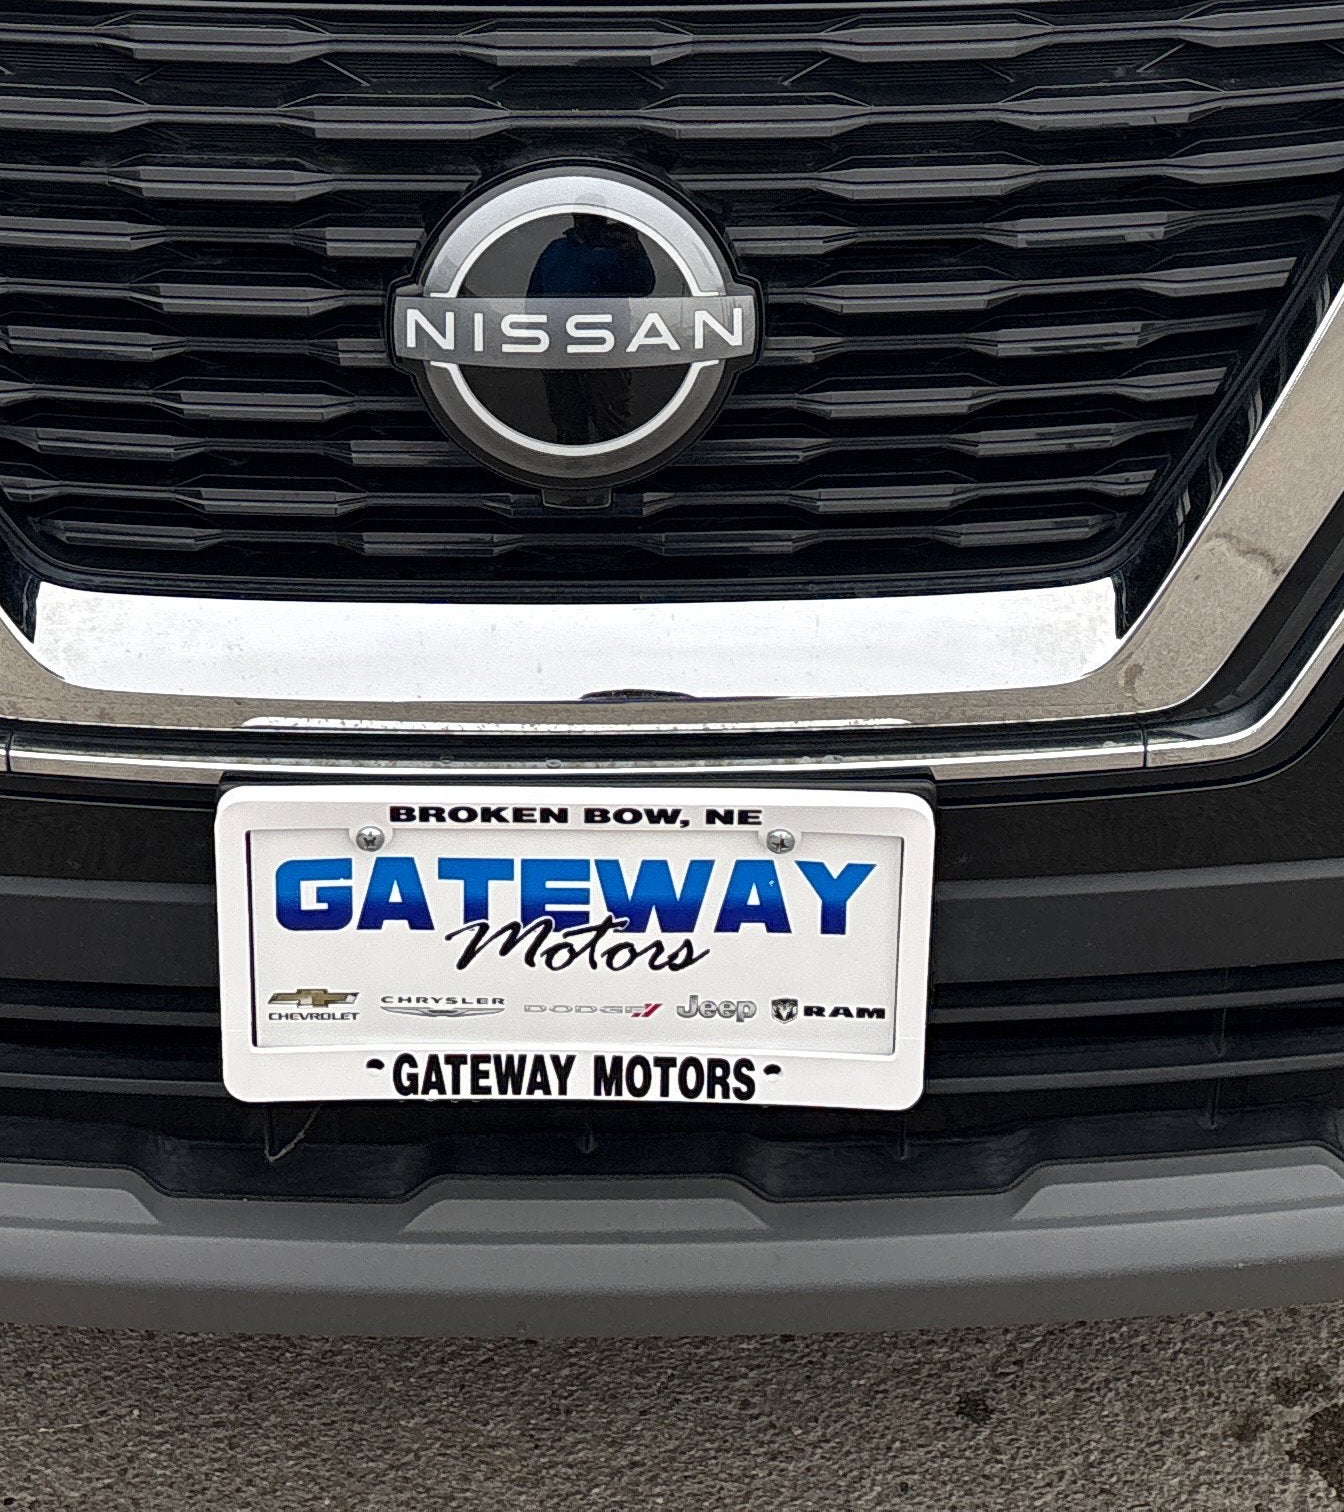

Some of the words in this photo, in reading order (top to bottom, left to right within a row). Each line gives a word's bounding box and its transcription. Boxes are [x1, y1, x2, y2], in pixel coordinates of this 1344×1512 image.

[406, 307, 743, 354] NISSAN
[389, 805, 569, 824] BROKEN
[584, 807, 691, 829] BOW,
[706, 808, 764, 826] NE
[275, 856, 878, 935] GATEWAY
[444, 915, 711, 972] Motors
[380, 995, 505, 1006] CHRYSLER
[523, 1004, 646, 1015] DODGE
[676, 994, 757, 1023] Jeep
[803, 1005, 886, 1020] RAM
[268, 1012, 360, 1022] CHEVROLET
[393, 1053, 577, 1097] GATEWAY
[594, 1055, 756, 1101] MOTORS
